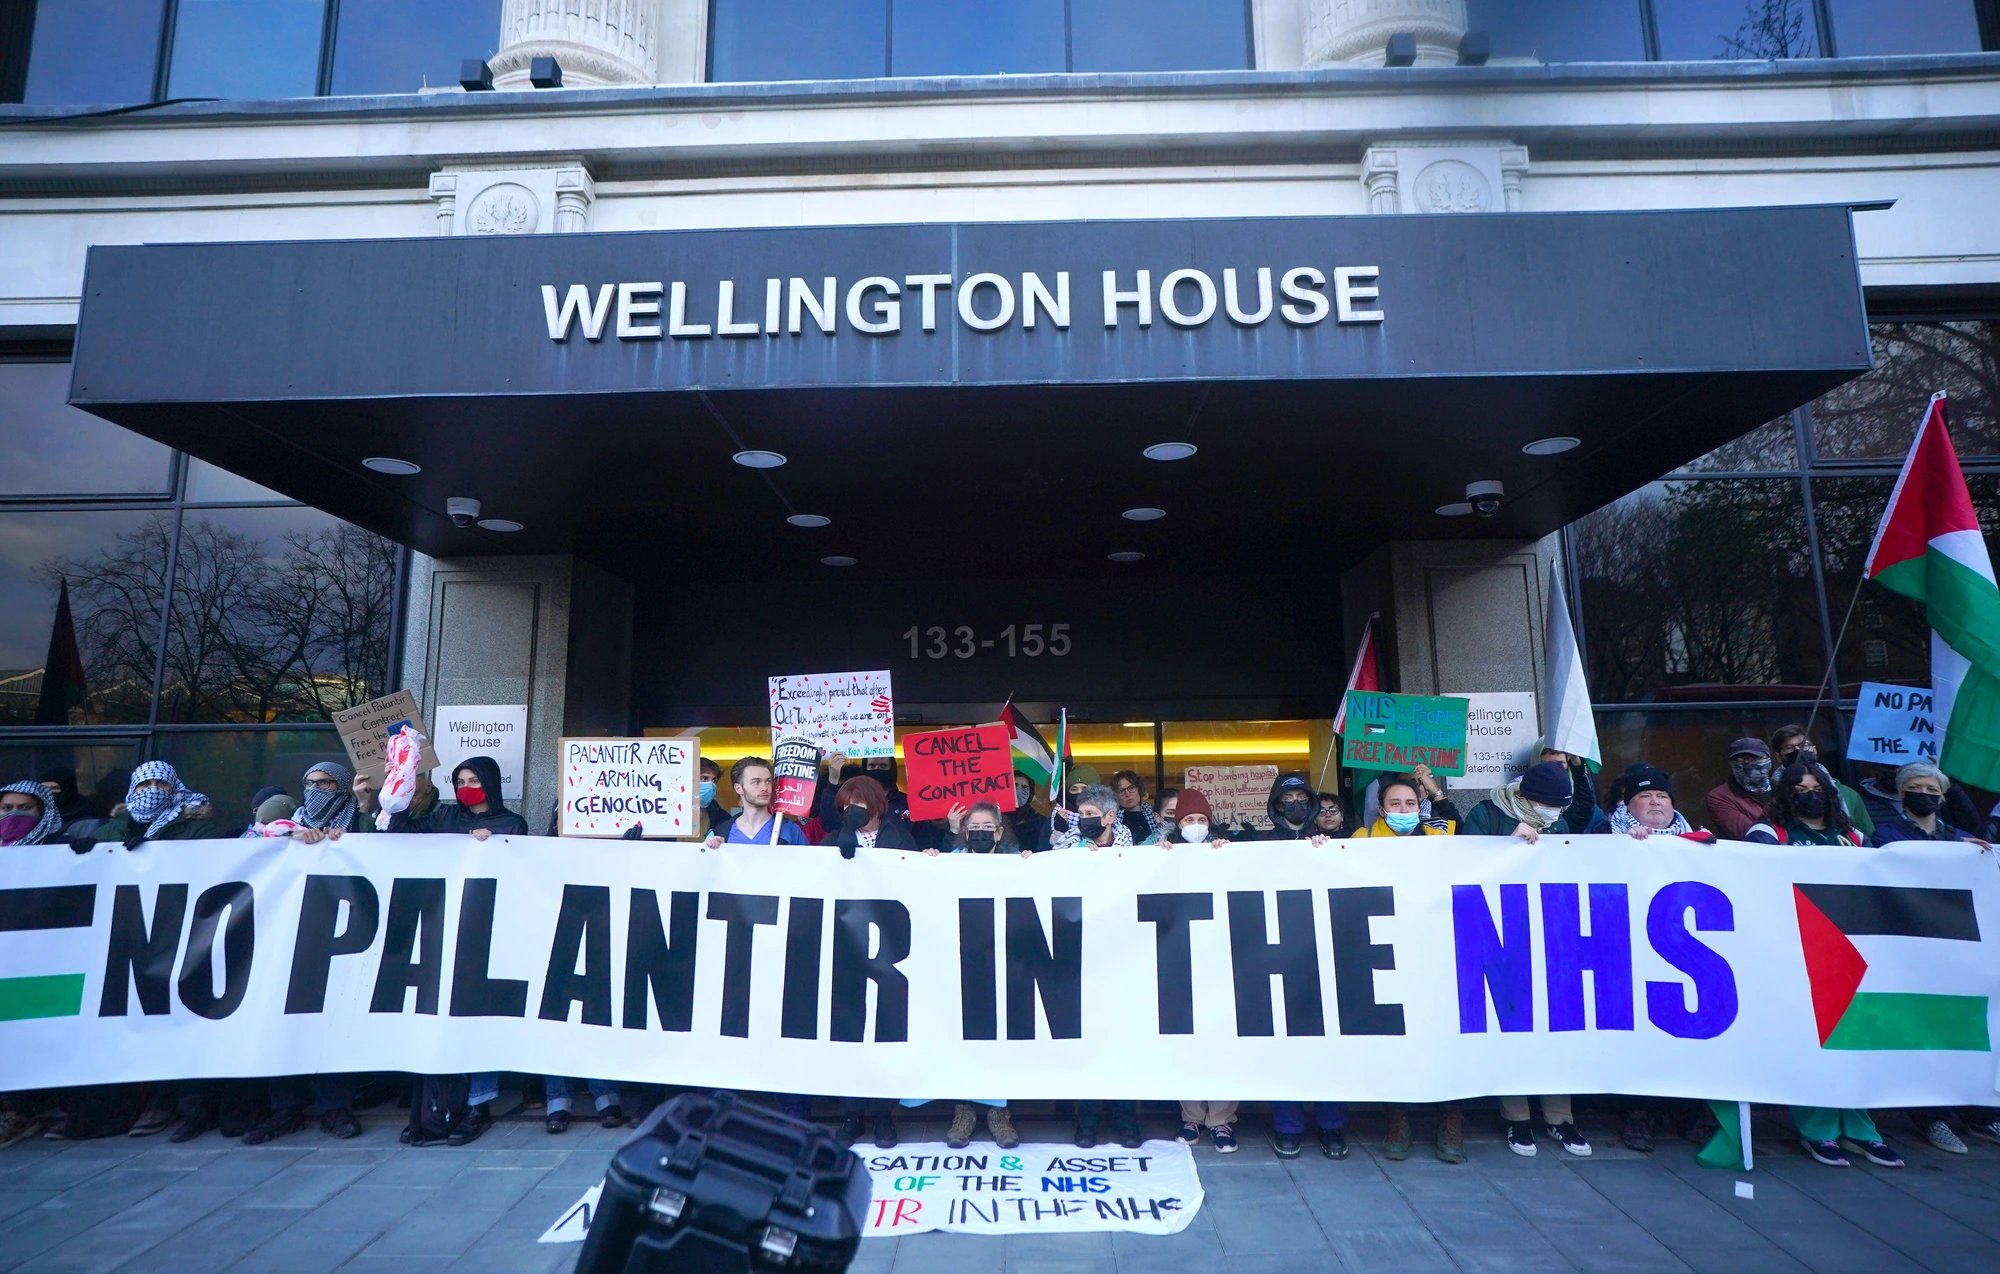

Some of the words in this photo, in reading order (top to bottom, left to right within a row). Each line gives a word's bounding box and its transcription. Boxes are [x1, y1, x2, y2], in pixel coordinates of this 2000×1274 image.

[541, 271, 1070, 341] WELLINGTON
[1104, 266, 1385, 330] HOUSE
[903, 624, 1072, 659] 133-155
[829, 681, 851, 702] proud
[852, 682, 868, 696] that
[869, 682, 888, 698] after
[338, 707, 371, 723] Cancel
[371, 696, 406, 712] Palantir
[1351, 695, 1396, 721] NHS
[1874, 692, 1903, 710] NO
[1907, 693, 1933, 713] PA
[361, 709, 407, 731] Contract
[775, 704, 793, 725] Oct
[860, 712, 873, 721] are
[877, 712, 888, 720] on
[1468, 709, 1523, 723] ellington
[449, 721, 514, 735] Wellington
[839, 726, 858, 735] crucial
[1470, 724, 1512, 736] House
[1909, 716, 1934, 734] IN
[350, 738, 371, 749] Free
[373, 732, 387, 741] the
[460, 736, 501, 747] House
[915, 733, 1000, 755] CANCEL
[1868, 737, 1909, 753] THE
[356, 749, 377, 761] Free
[647, 744, 681, 764] ARE
[776, 744, 817, 760] FREEDOM
[1346, 739, 1383, 762] FREE
[1384, 742, 1461, 769] PALESTINE
[1473, 752, 1513, 761] 133-155
[937, 757, 981, 776] THE
[1467, 764, 1501, 773] aterloo
[1503, 763, 1529, 773] Road
[1187, 769, 1214, 783] Stop
[1218, 770, 1249, 783] bombing
[918, 773, 1012, 800] CONTRACT
[1215, 784, 1235, 797] killing
[1215, 800, 1237, 813] killing
[1230, 811, 1239, 825] A
[98, 881, 255, 1020] NO
[284, 874, 911, 1043] PALANTIR
[958, 897, 1082, 1040] IN
[1137, 886, 1406, 1037] THE
[1451, 881, 1738, 1040] NHS
[864, 1155, 988, 1172] SATION
[1000, 1156, 1024, 1171] &
[1046, 1157, 1152, 1172] ASSET
[894, 1176, 942, 1192] OF
[956, 1176, 1023, 1191] THE
[1041, 1177, 1111, 1193] NHS
[948, 1198, 999, 1224] IN
